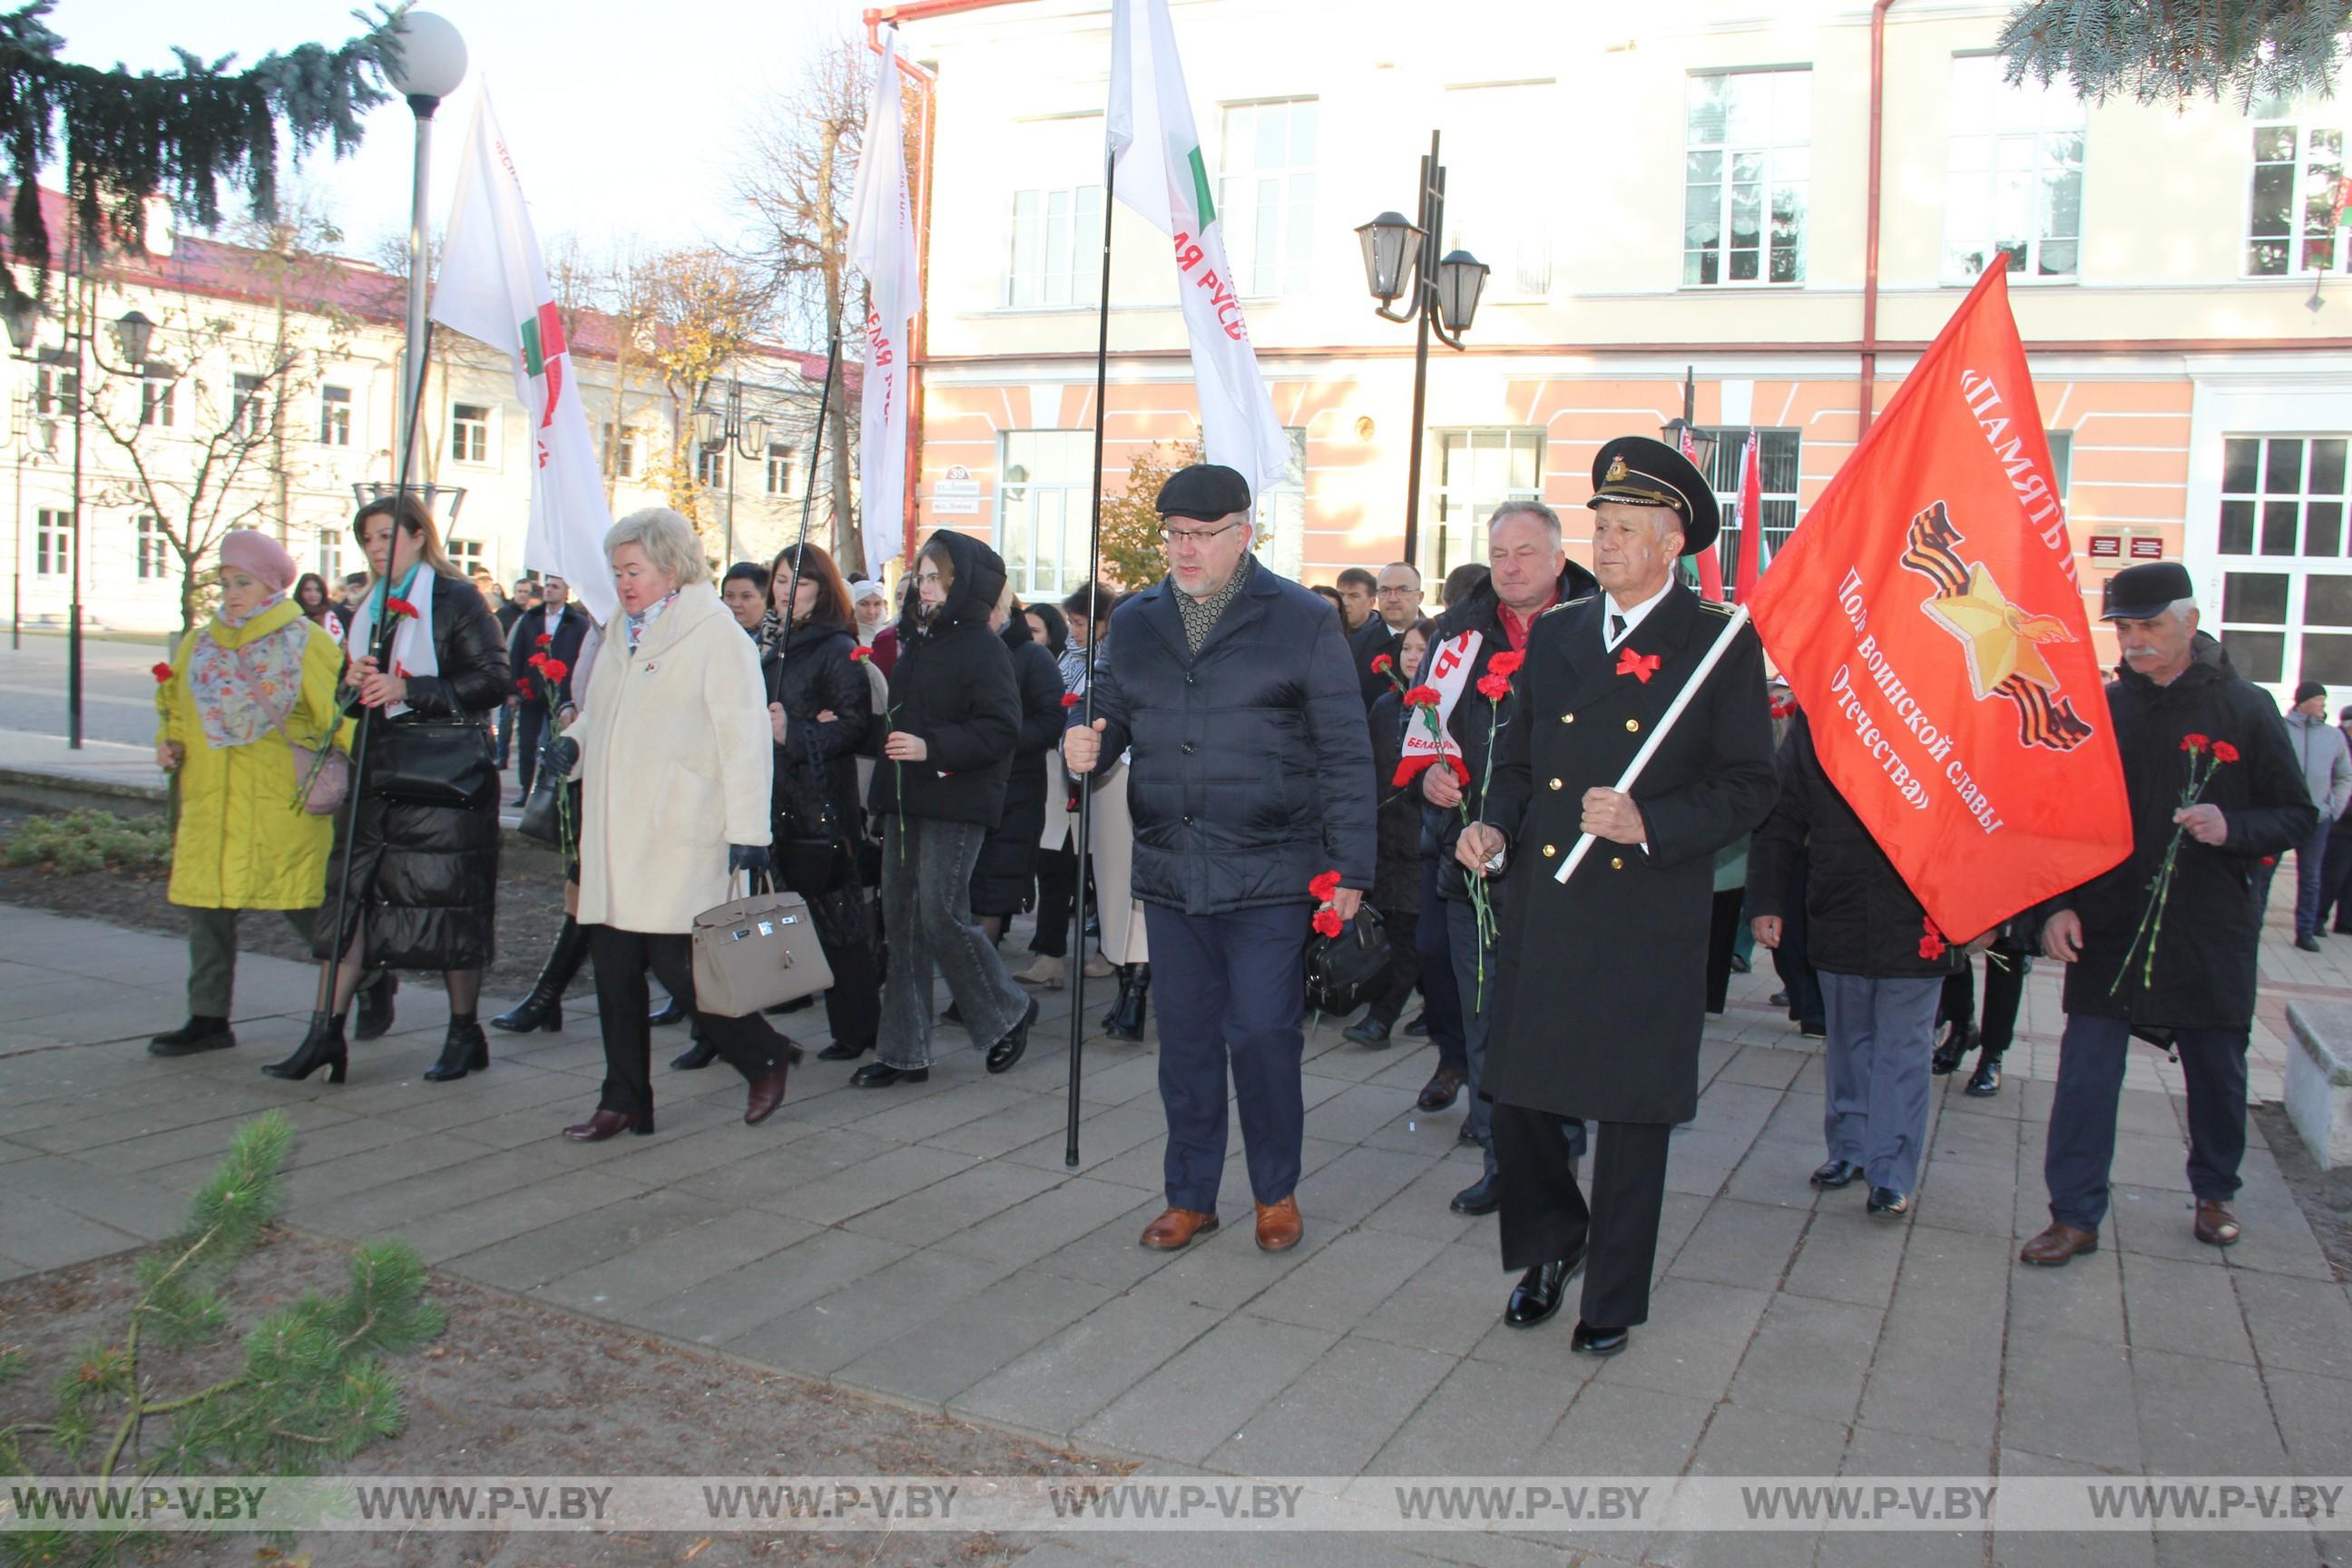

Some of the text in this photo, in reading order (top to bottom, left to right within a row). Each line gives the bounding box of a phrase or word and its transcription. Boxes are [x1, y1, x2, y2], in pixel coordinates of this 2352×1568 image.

[1197, 269, 1241, 340] РУСЬ
[1960, 369, 2065, 550] «ПАМЯТЬ
[1831, 663, 1929, 809] Отечества»
[1857, 634, 1953, 762] воинской
[1945, 760, 2004, 835] славы
